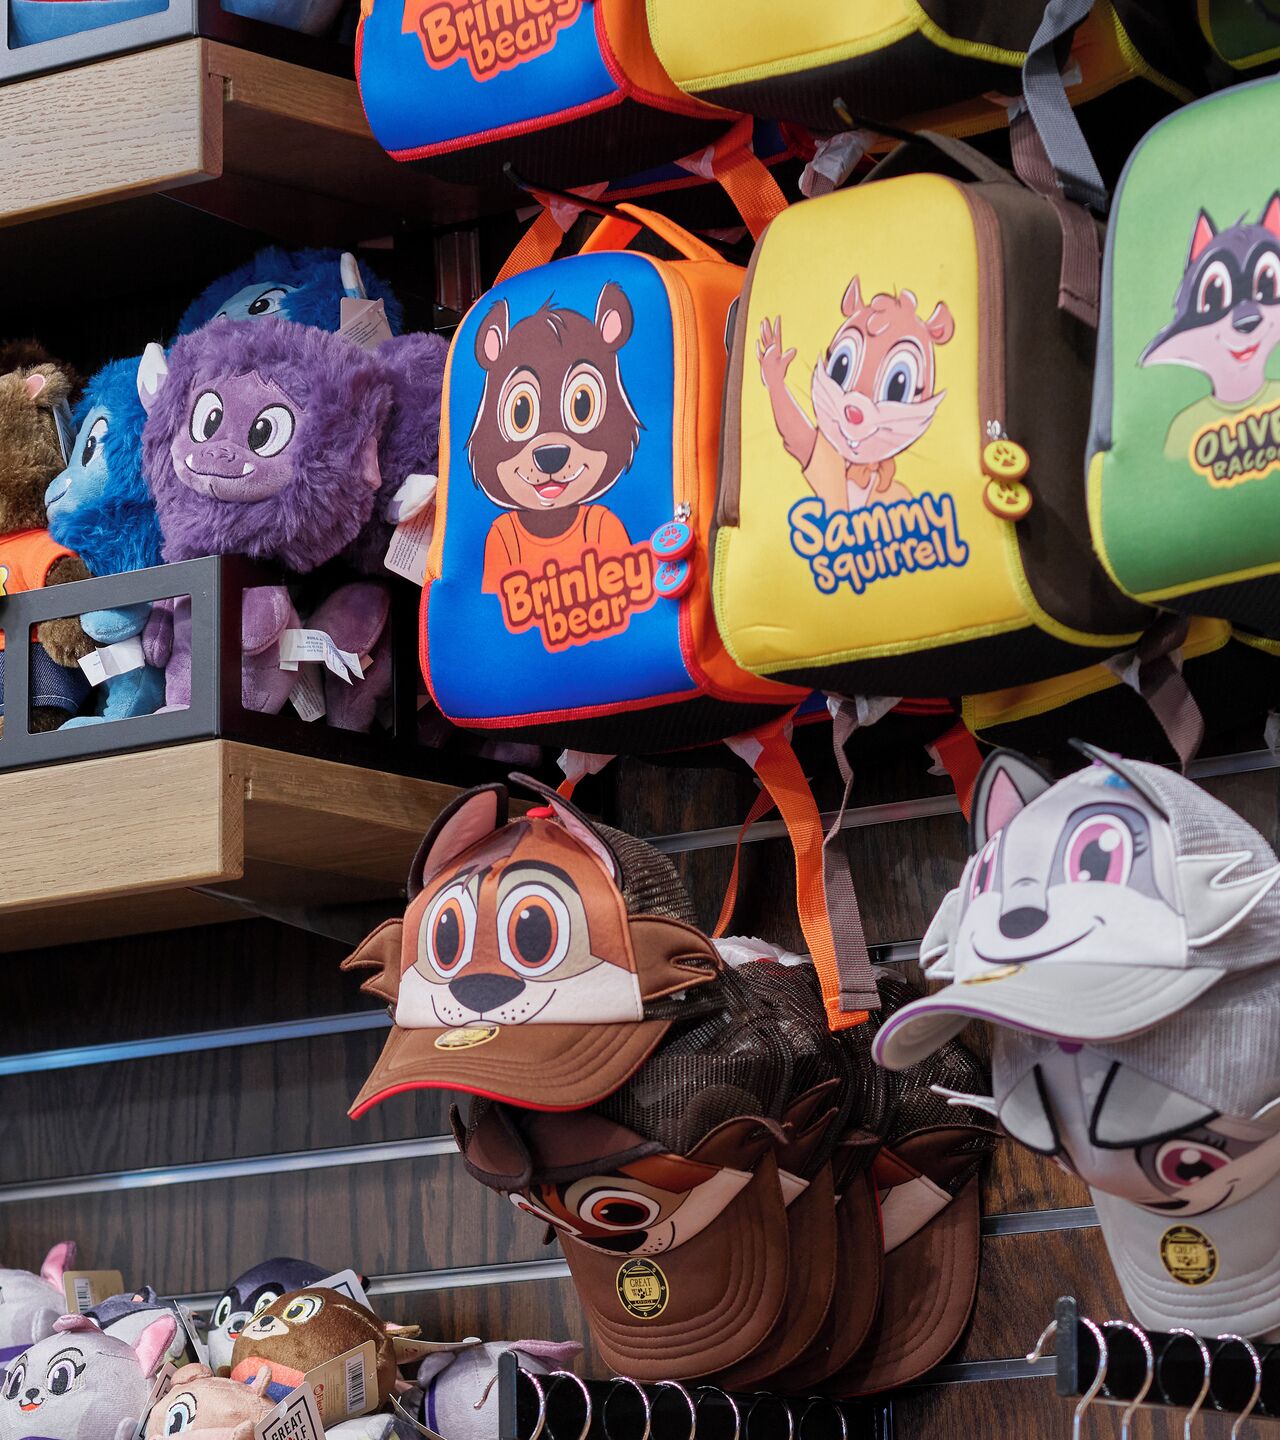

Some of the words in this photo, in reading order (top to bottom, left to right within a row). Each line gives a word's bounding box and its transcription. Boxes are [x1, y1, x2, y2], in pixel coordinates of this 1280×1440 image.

[423, 0, 577, 57] Brin
[471, 12, 553, 70] bear
[791, 496, 966, 563] Sammy
[504, 549, 651, 622] Brinley
[813, 530, 945, 591] squirrel
[545, 598, 626, 642] bear
[629, 1278, 651, 1288] GREAT
